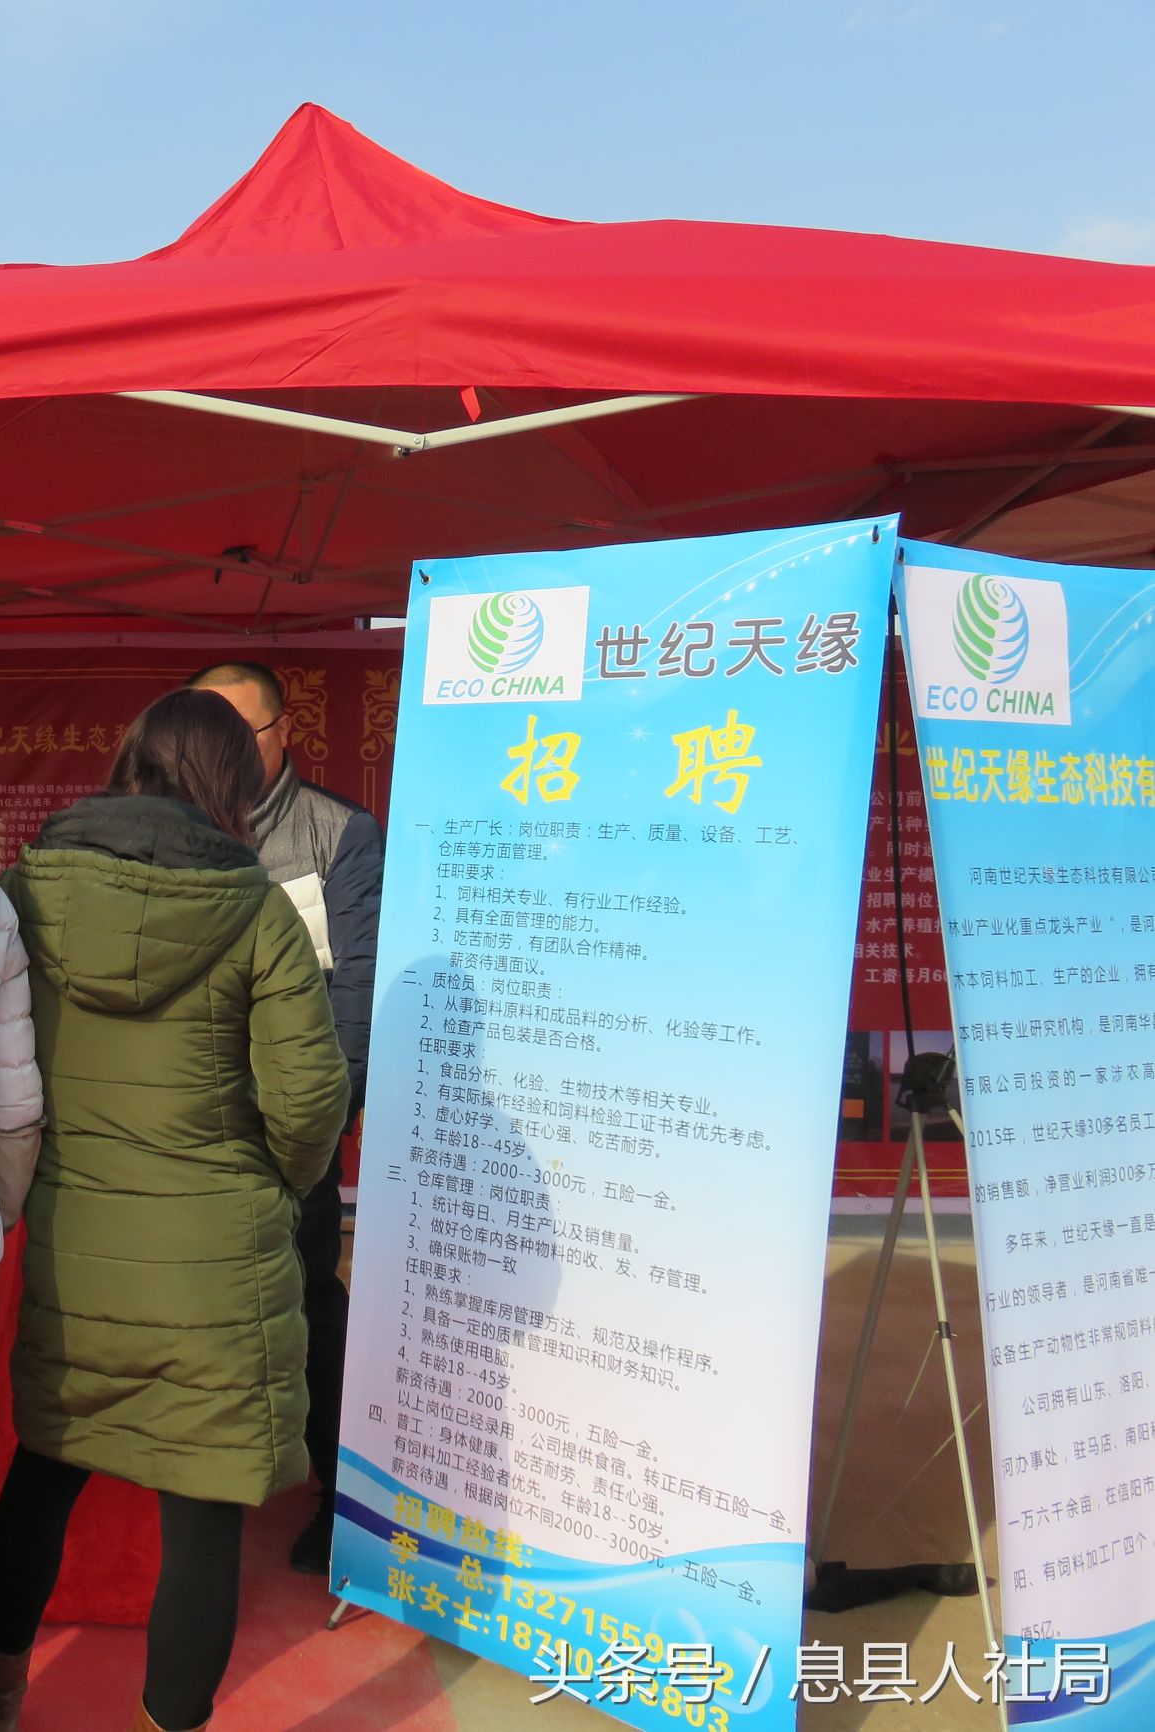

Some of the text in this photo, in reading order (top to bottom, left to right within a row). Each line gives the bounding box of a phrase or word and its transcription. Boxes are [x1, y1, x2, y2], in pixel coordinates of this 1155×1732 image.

[595, 611, 860, 679] 世纪天缘
[437, 675, 564, 699] ECO CHINA
[926, 685, 1055, 716] ECO CHINA
[438, 841, 548, 861] 仓库等方面管理。
[436, 862, 504, 881] 任职要求：
[969, 866, 1155, 885] 河南世纪天缘生态科技有限公
[959, 1012, 1155, 1042] 本饲料专业研究机构，是河南华
[991, 1317, 1155, 1368] 设备生产动物性非常规饲料
